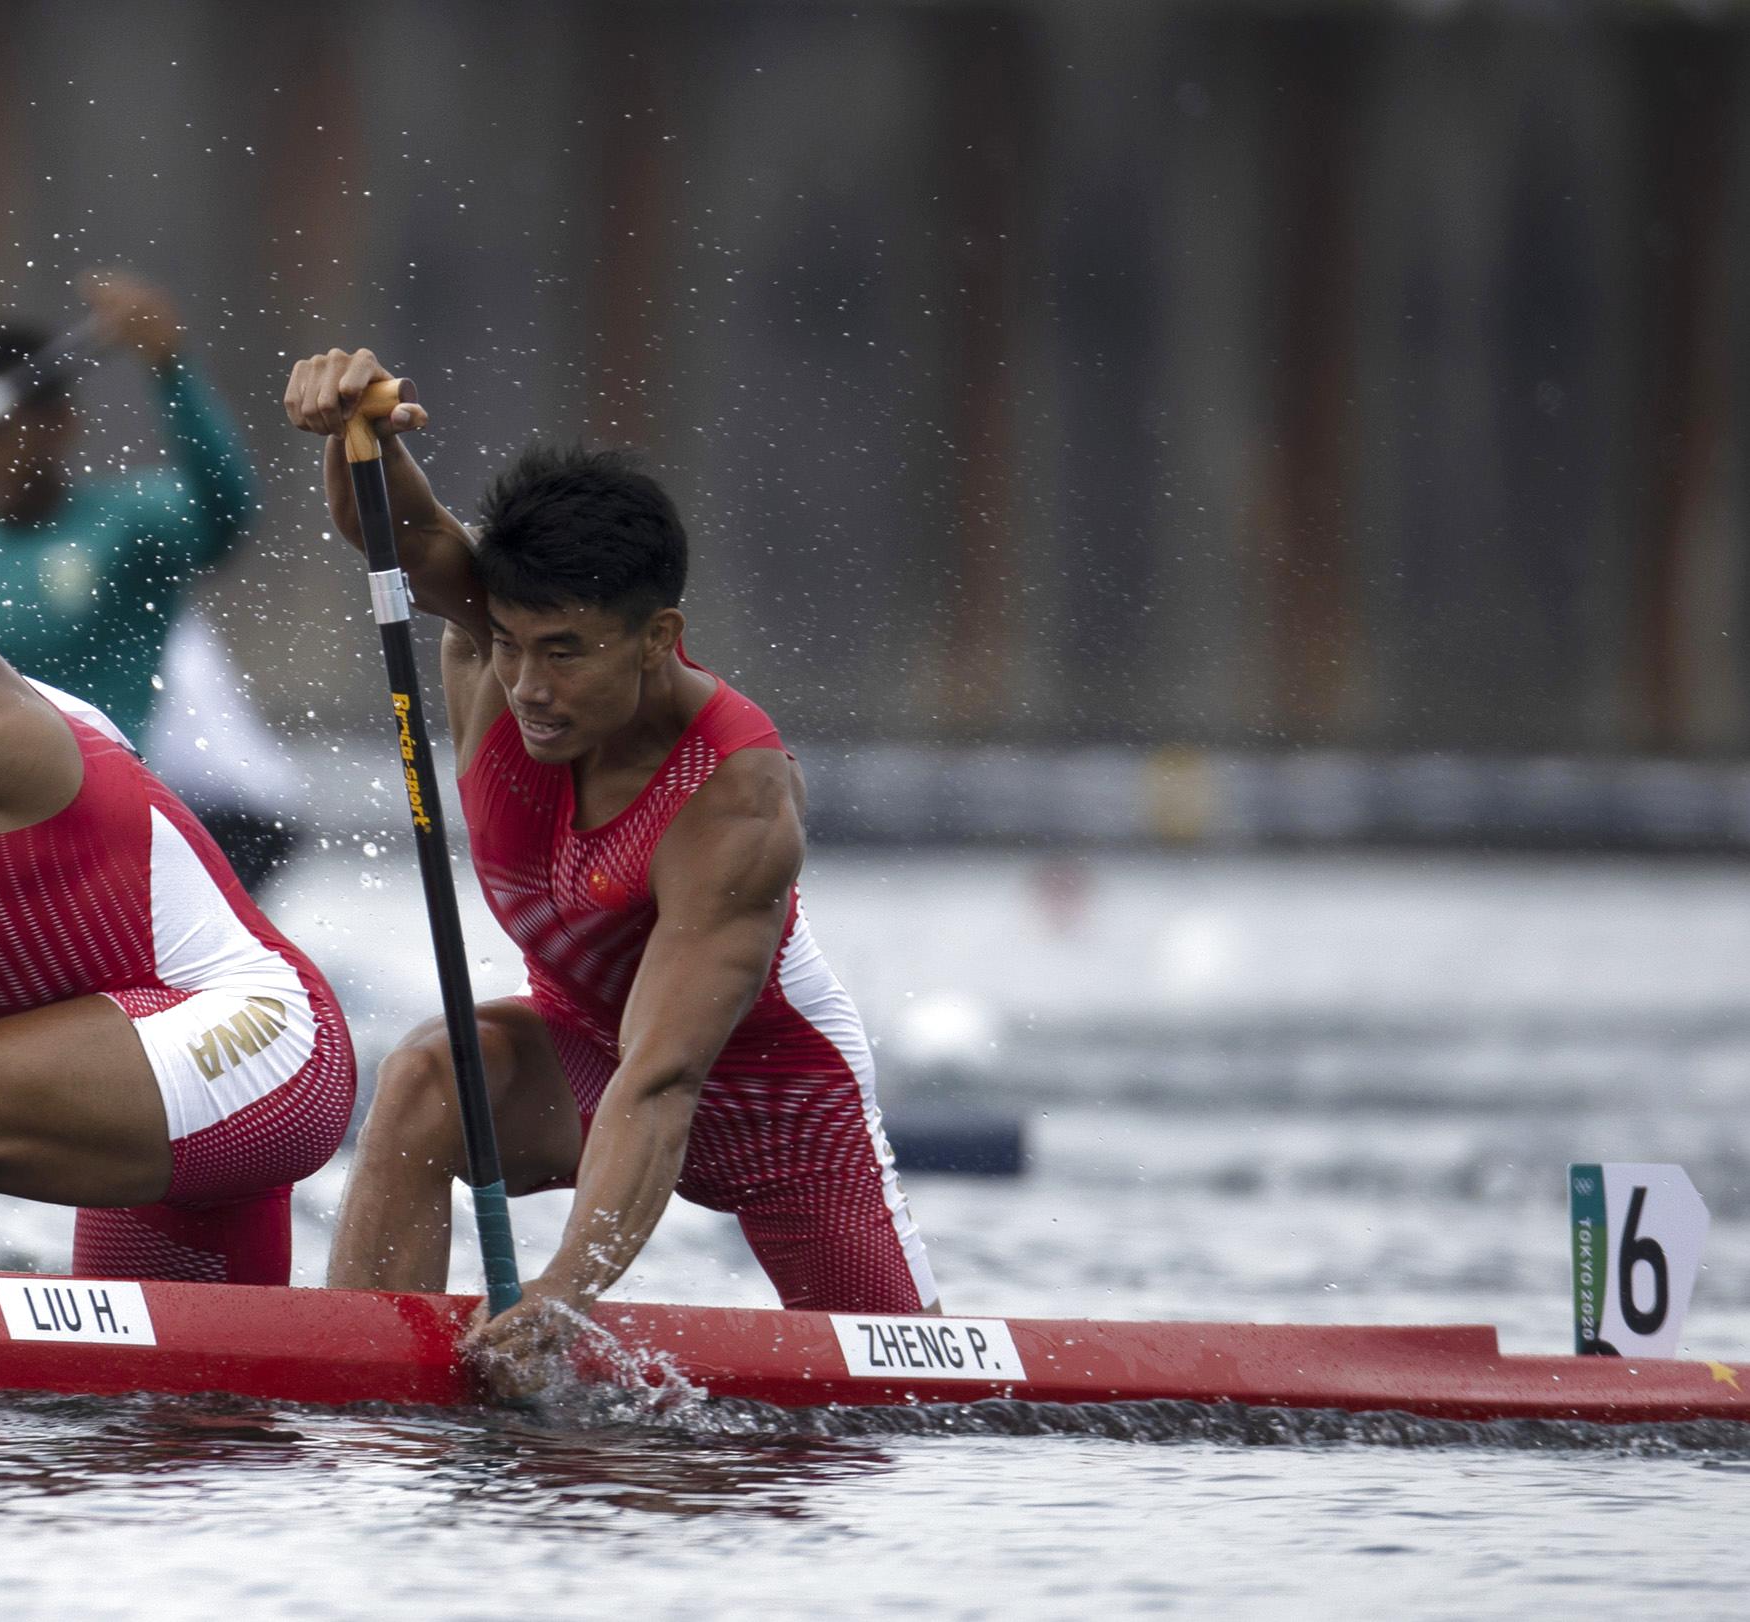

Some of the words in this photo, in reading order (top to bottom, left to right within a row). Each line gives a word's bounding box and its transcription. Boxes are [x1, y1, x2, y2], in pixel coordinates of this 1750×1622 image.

[1578, 1216, 1594, 1287] TOKYO
[1619, 1186, 1669, 1336] 6
[23, 1287, 82, 1332] LIU
[88, 1289, 129, 1334] H.
[1579, 1289, 1595, 1341] 2020
[856, 1323, 964, 1369] ZHENG
[965, 1326, 1001, 1369] P.
